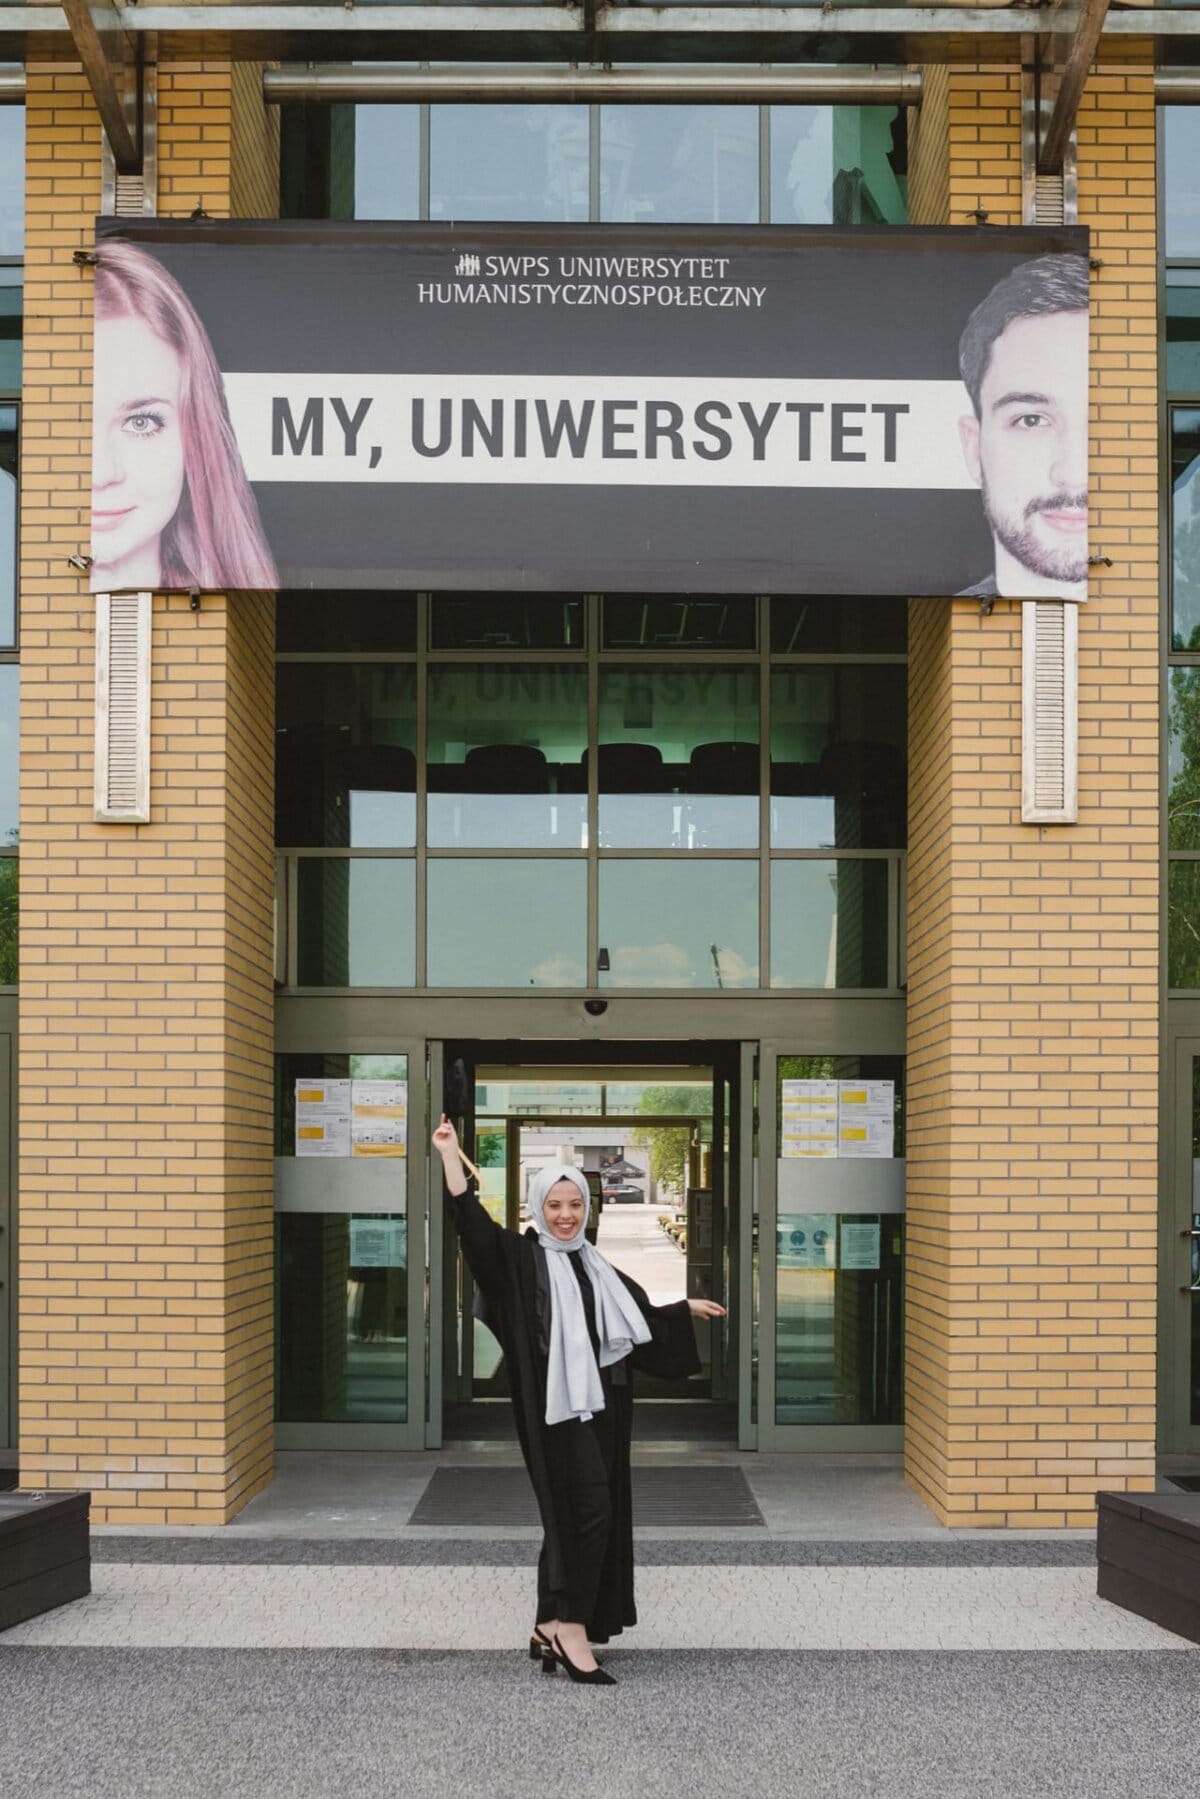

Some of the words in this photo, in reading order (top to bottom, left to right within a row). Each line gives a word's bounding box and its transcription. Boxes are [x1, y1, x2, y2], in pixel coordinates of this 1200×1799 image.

[485, 256, 550, 277] SWPS
[558, 257, 731, 279] UNIWERSYTET
[417, 283, 767, 307] HUMANISTYCZNOSPOŁECZNY
[271, 396, 383, 469] MY,
[411, 397, 910, 463] UNIWERSYTET
